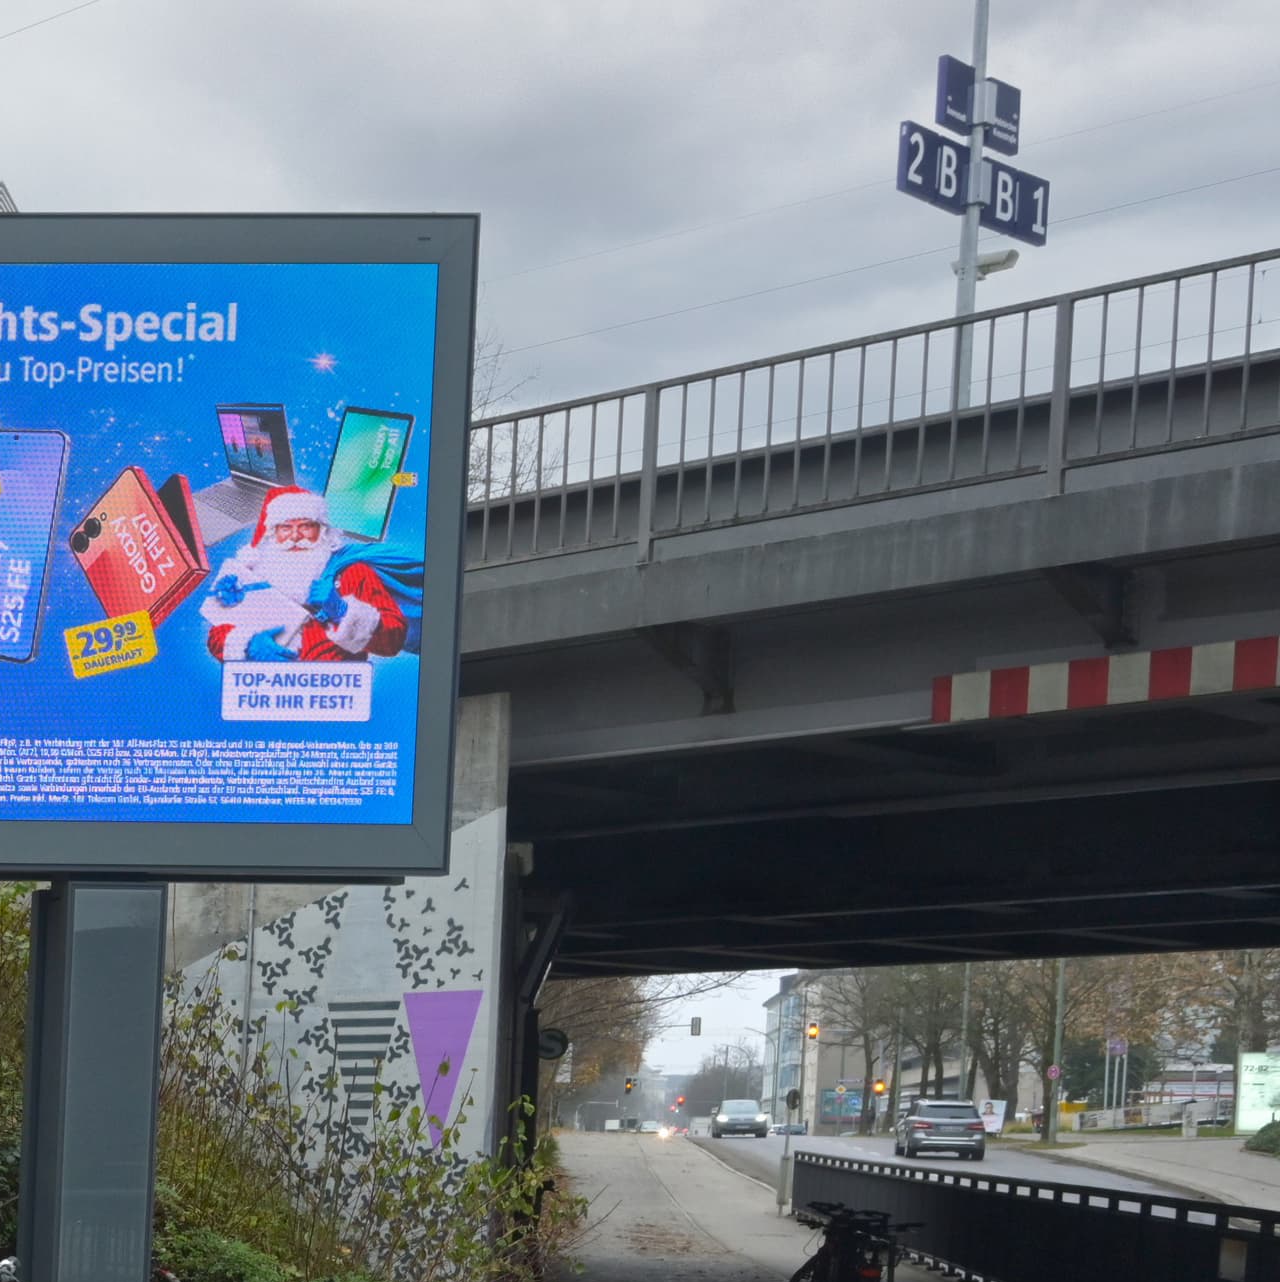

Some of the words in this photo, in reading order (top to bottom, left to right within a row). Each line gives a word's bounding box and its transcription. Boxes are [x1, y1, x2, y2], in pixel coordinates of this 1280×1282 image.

[907, 132, 924, 186] 2
[941, 145, 958, 198] B
[995, 170, 1014, 222] B
[1032, 186, 1045, 235] 1
[110, 516, 157, 595] Galaxy
[132, 513, 166, 561] Flip7
[156, 557, 176, 577] Z
[0, 596, 24, 643] S25
[12, 558, 32, 591] FE
[76, 621, 137, 659] 29,99
[83, 648, 143, 671] DAUERHAFT
[232, 671, 362, 688] TOP-ANGEBOTE
[237, 690, 270, 709] FÜR
[275, 694, 304, 709] IHR
[310, 694, 354, 710] FEST!
